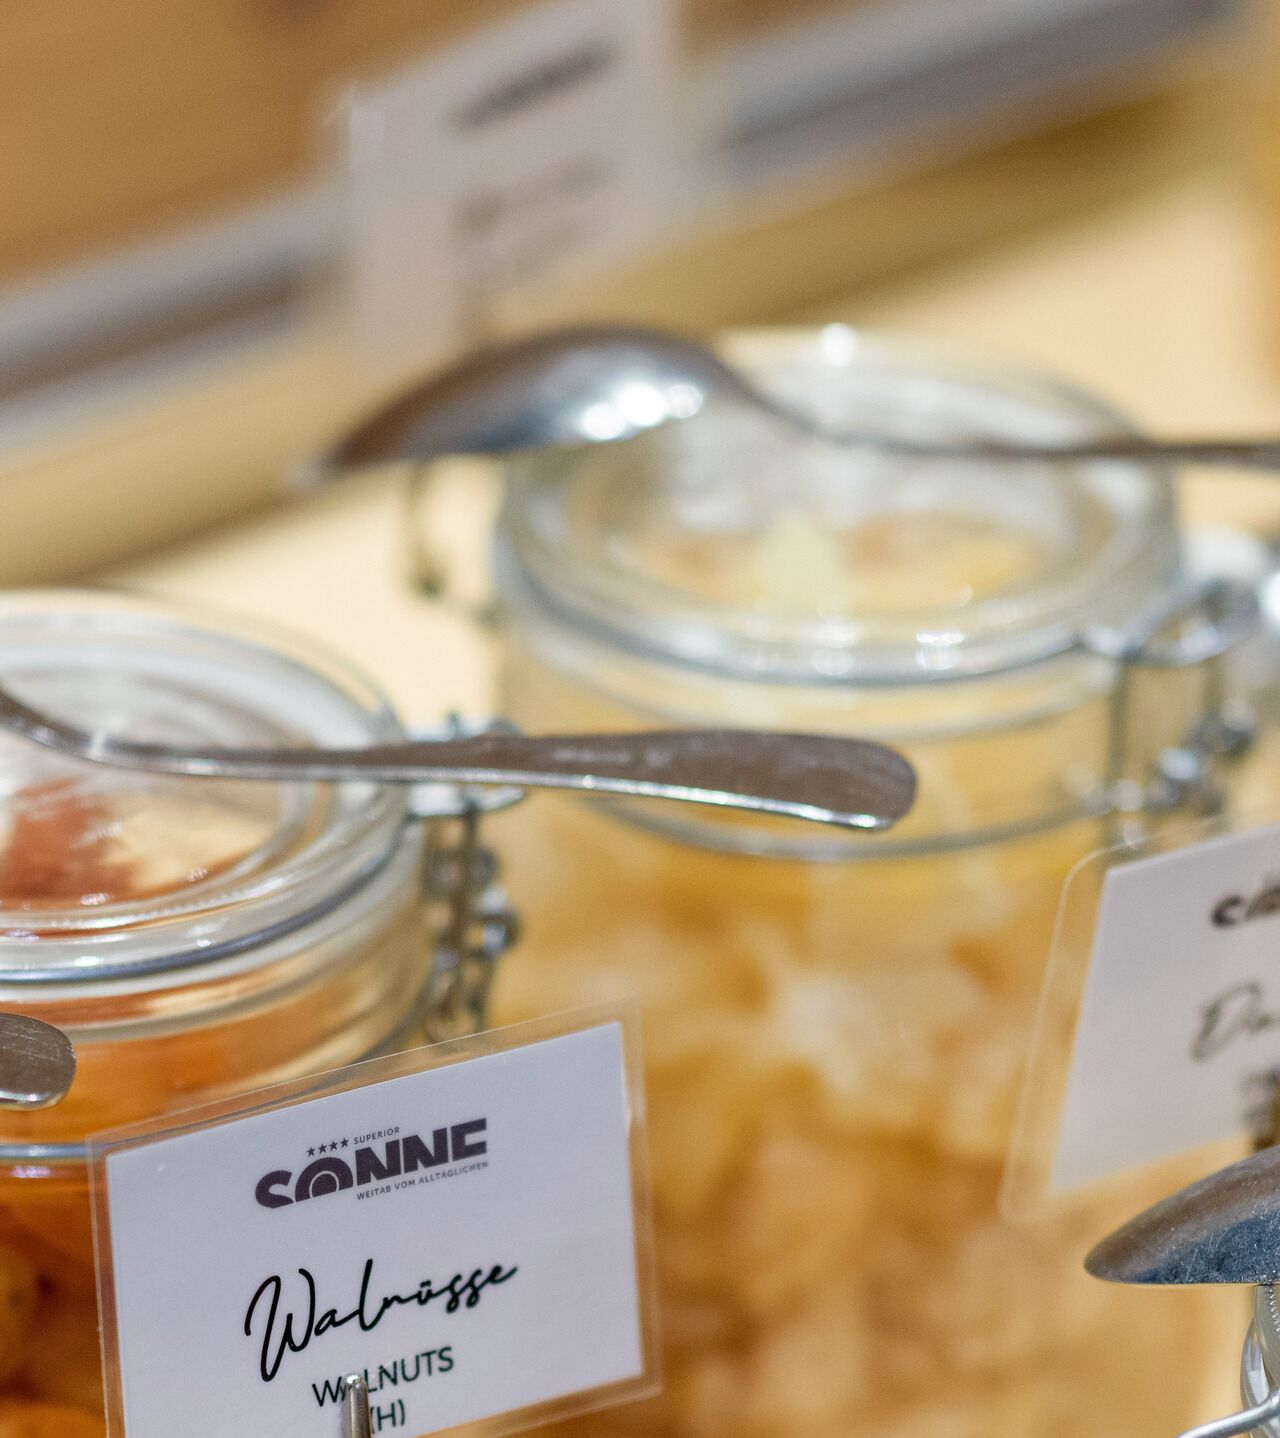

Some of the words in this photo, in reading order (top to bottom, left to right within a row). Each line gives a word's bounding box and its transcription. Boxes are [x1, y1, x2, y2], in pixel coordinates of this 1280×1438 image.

[255, 1117, 488, 1209] SONNE
[354, 1126, 401, 1145] SUPERIOR
[356, 1185, 392, 1201] WEITAB
[394, 1179, 416, 1192] VOM
[244, 1258, 519, 1382] Walnüsse
[311, 1346, 455, 1408] WLNUTS
